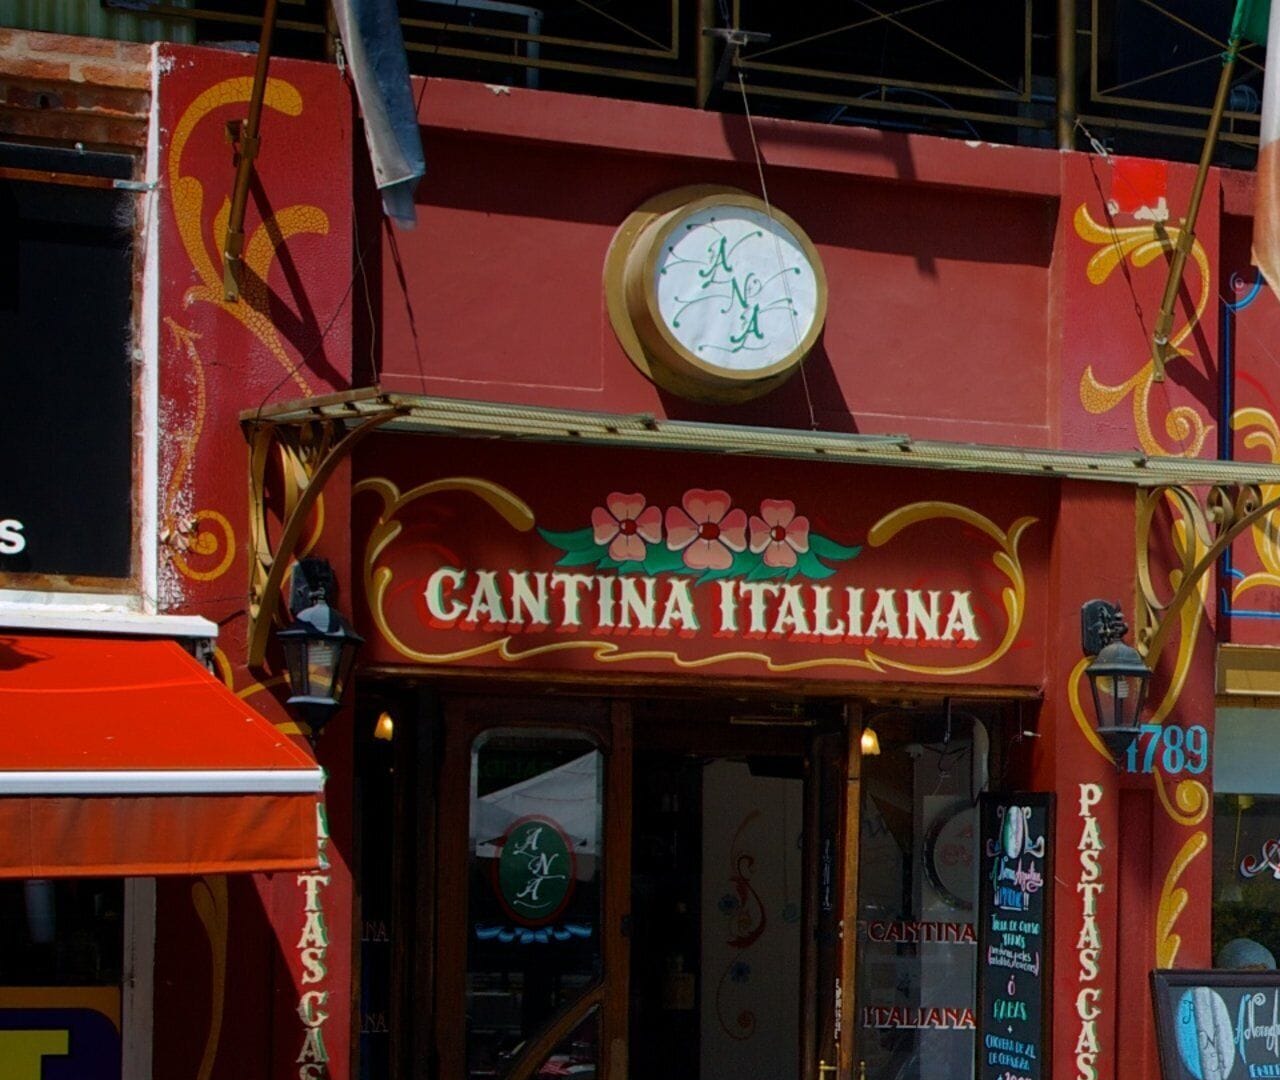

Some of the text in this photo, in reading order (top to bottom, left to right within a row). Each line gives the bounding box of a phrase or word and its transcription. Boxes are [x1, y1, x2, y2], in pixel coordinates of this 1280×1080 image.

[423, 567, 981, 642] CANTINA ITALIANA
[1077, 783, 1105, 983] PASTAS
[866, 920, 978, 945] CANTINA
[863, 1007, 977, 1030] ITALIANA
